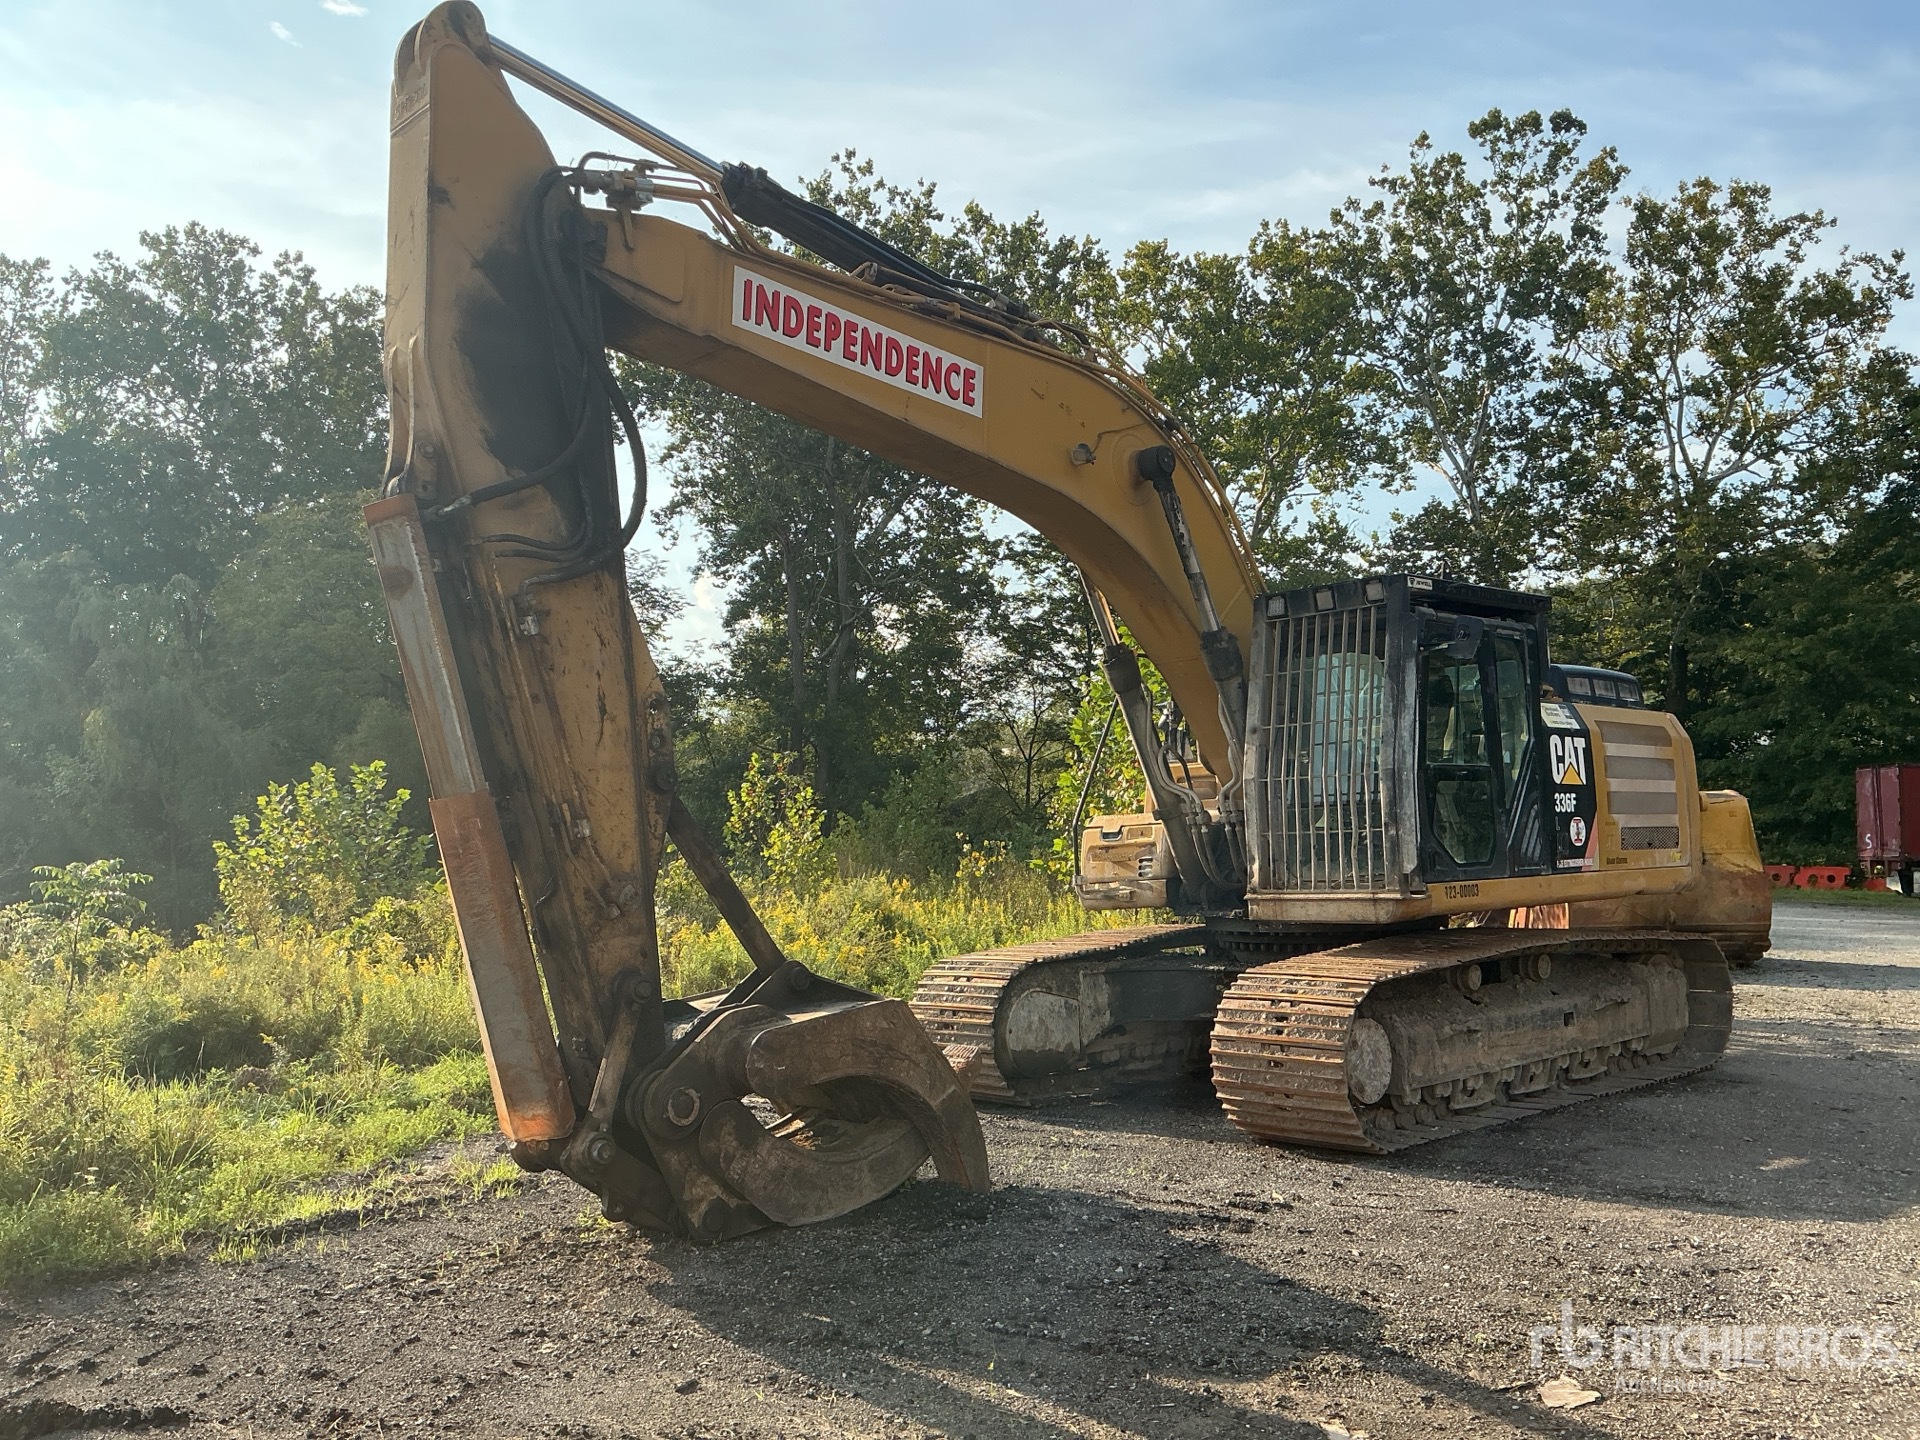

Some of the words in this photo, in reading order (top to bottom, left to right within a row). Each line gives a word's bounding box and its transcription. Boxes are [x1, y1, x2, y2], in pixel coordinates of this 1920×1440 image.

[742, 278, 976, 407] INDEPENDENCE
[1549, 734, 1587, 785] CAT
[1554, 792, 1577, 813] 336F
